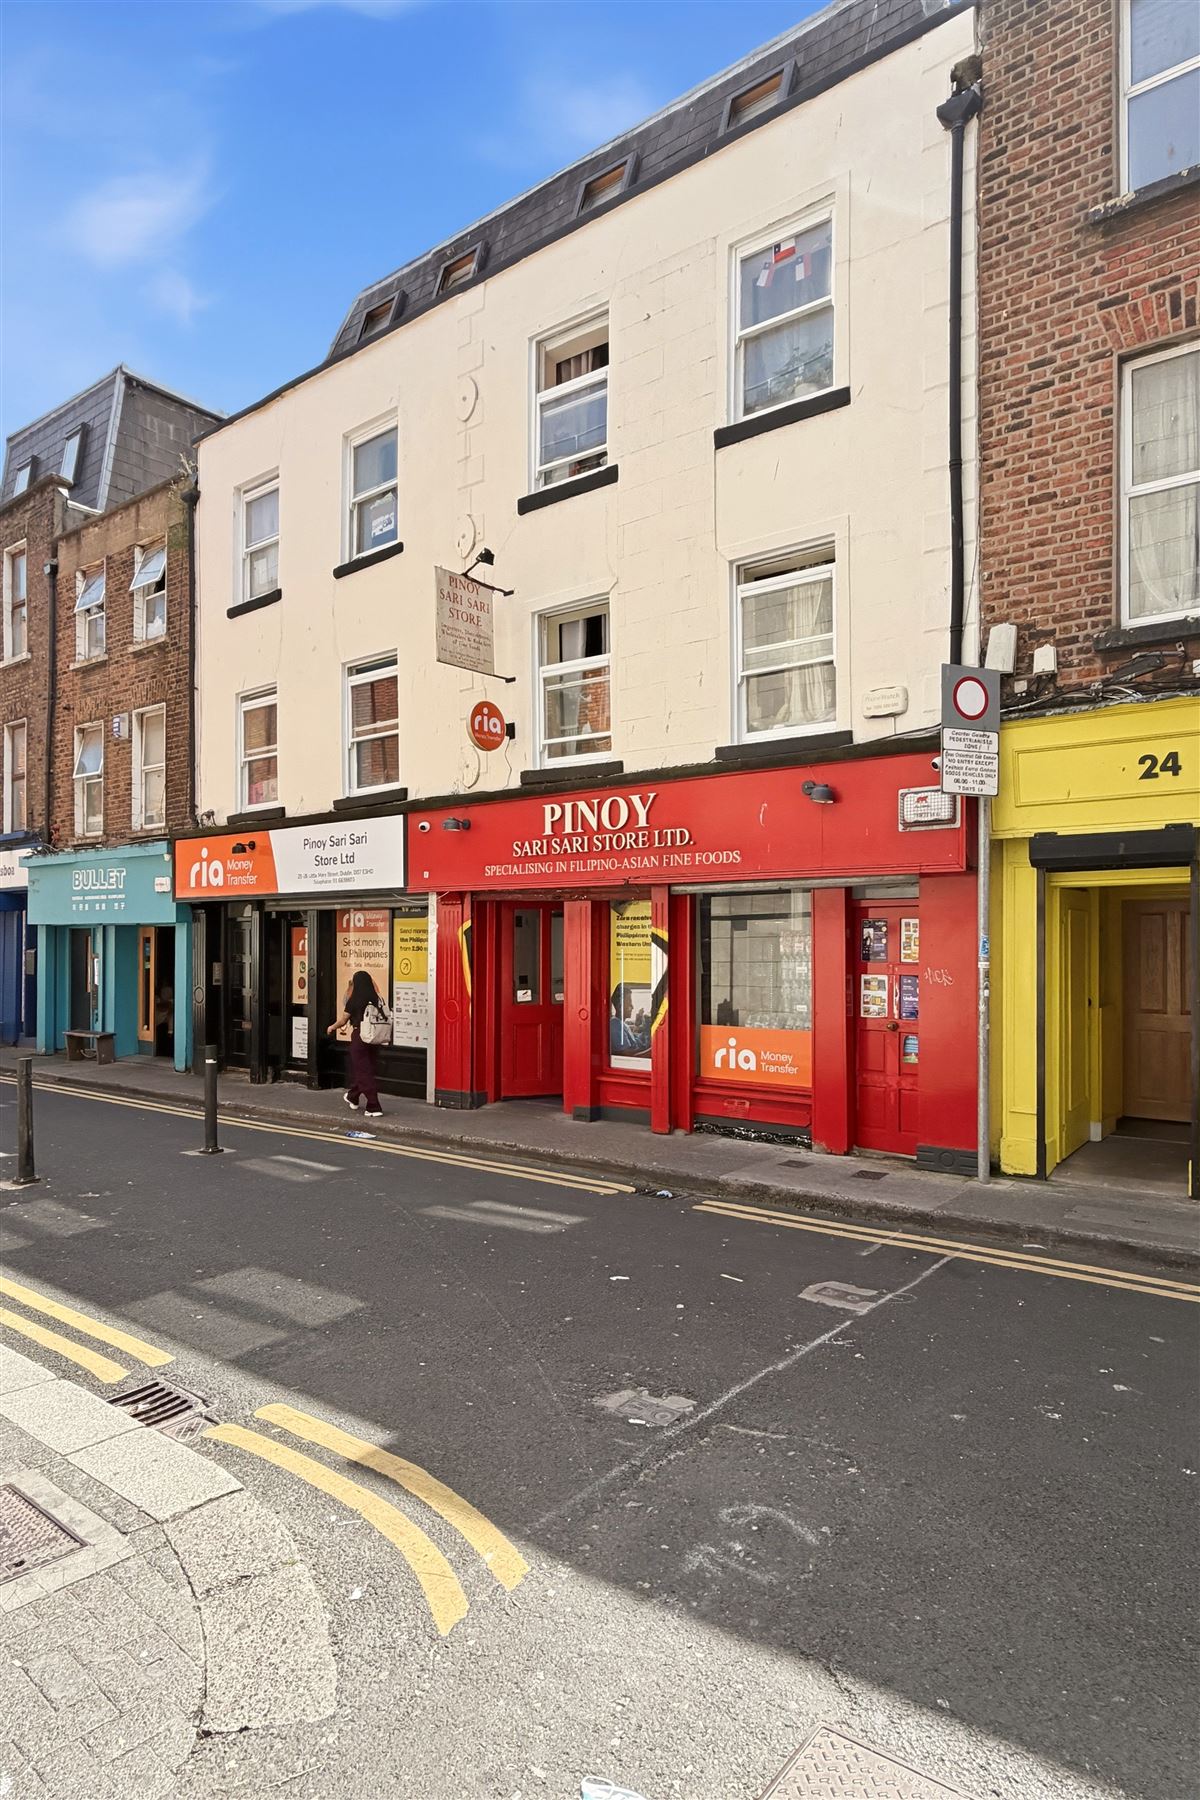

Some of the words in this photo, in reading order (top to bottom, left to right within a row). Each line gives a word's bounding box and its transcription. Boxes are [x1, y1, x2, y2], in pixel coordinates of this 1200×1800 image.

[449, 575, 480, 595] PINOY
[440, 588, 463, 605] SARI
[467, 597, 490, 614] SARI
[448, 607, 482, 626] STORE
[475, 707, 501, 734] ria
[1138, 751, 1182, 780] 24
[542, 793, 656, 836] PINOY
[303, 838, 327, 850] Pinoy
[329, 834, 347, 847] Sari
[349, 832, 368, 845] Sari
[513, 839, 547, 857] SARI
[551, 835, 589, 855] SARI
[593, 830, 649, 852] STORE
[653, 828, 694, 848] LTD.
[190, 847, 224, 888] ria
[227, 859, 253, 872] Money
[314, 855, 338, 866] Store
[340, 852, 355, 864] Ltd
[485, 861, 553, 876] SPECIALISING
[555, 861, 567, 873] IN
[570, 855, 659, 872] FILIPINO-ASIAN
[663, 853, 691, 867] FINE
[695, 850, 741, 865] FOODS
[73, 868, 126, 890] BULLET
[226, 872, 258, 885] Transfer
[342, 909, 365, 928] ria
[343, 937, 360, 947] Send
[362, 939, 385, 948] money
[341, 949, 347, 958] to
[349, 949, 388, 960] Philippines
[714, 1037, 757, 1071] ria
[760, 1051, 793, 1064] Money
[760, 1062, 799, 1074] Transfer
